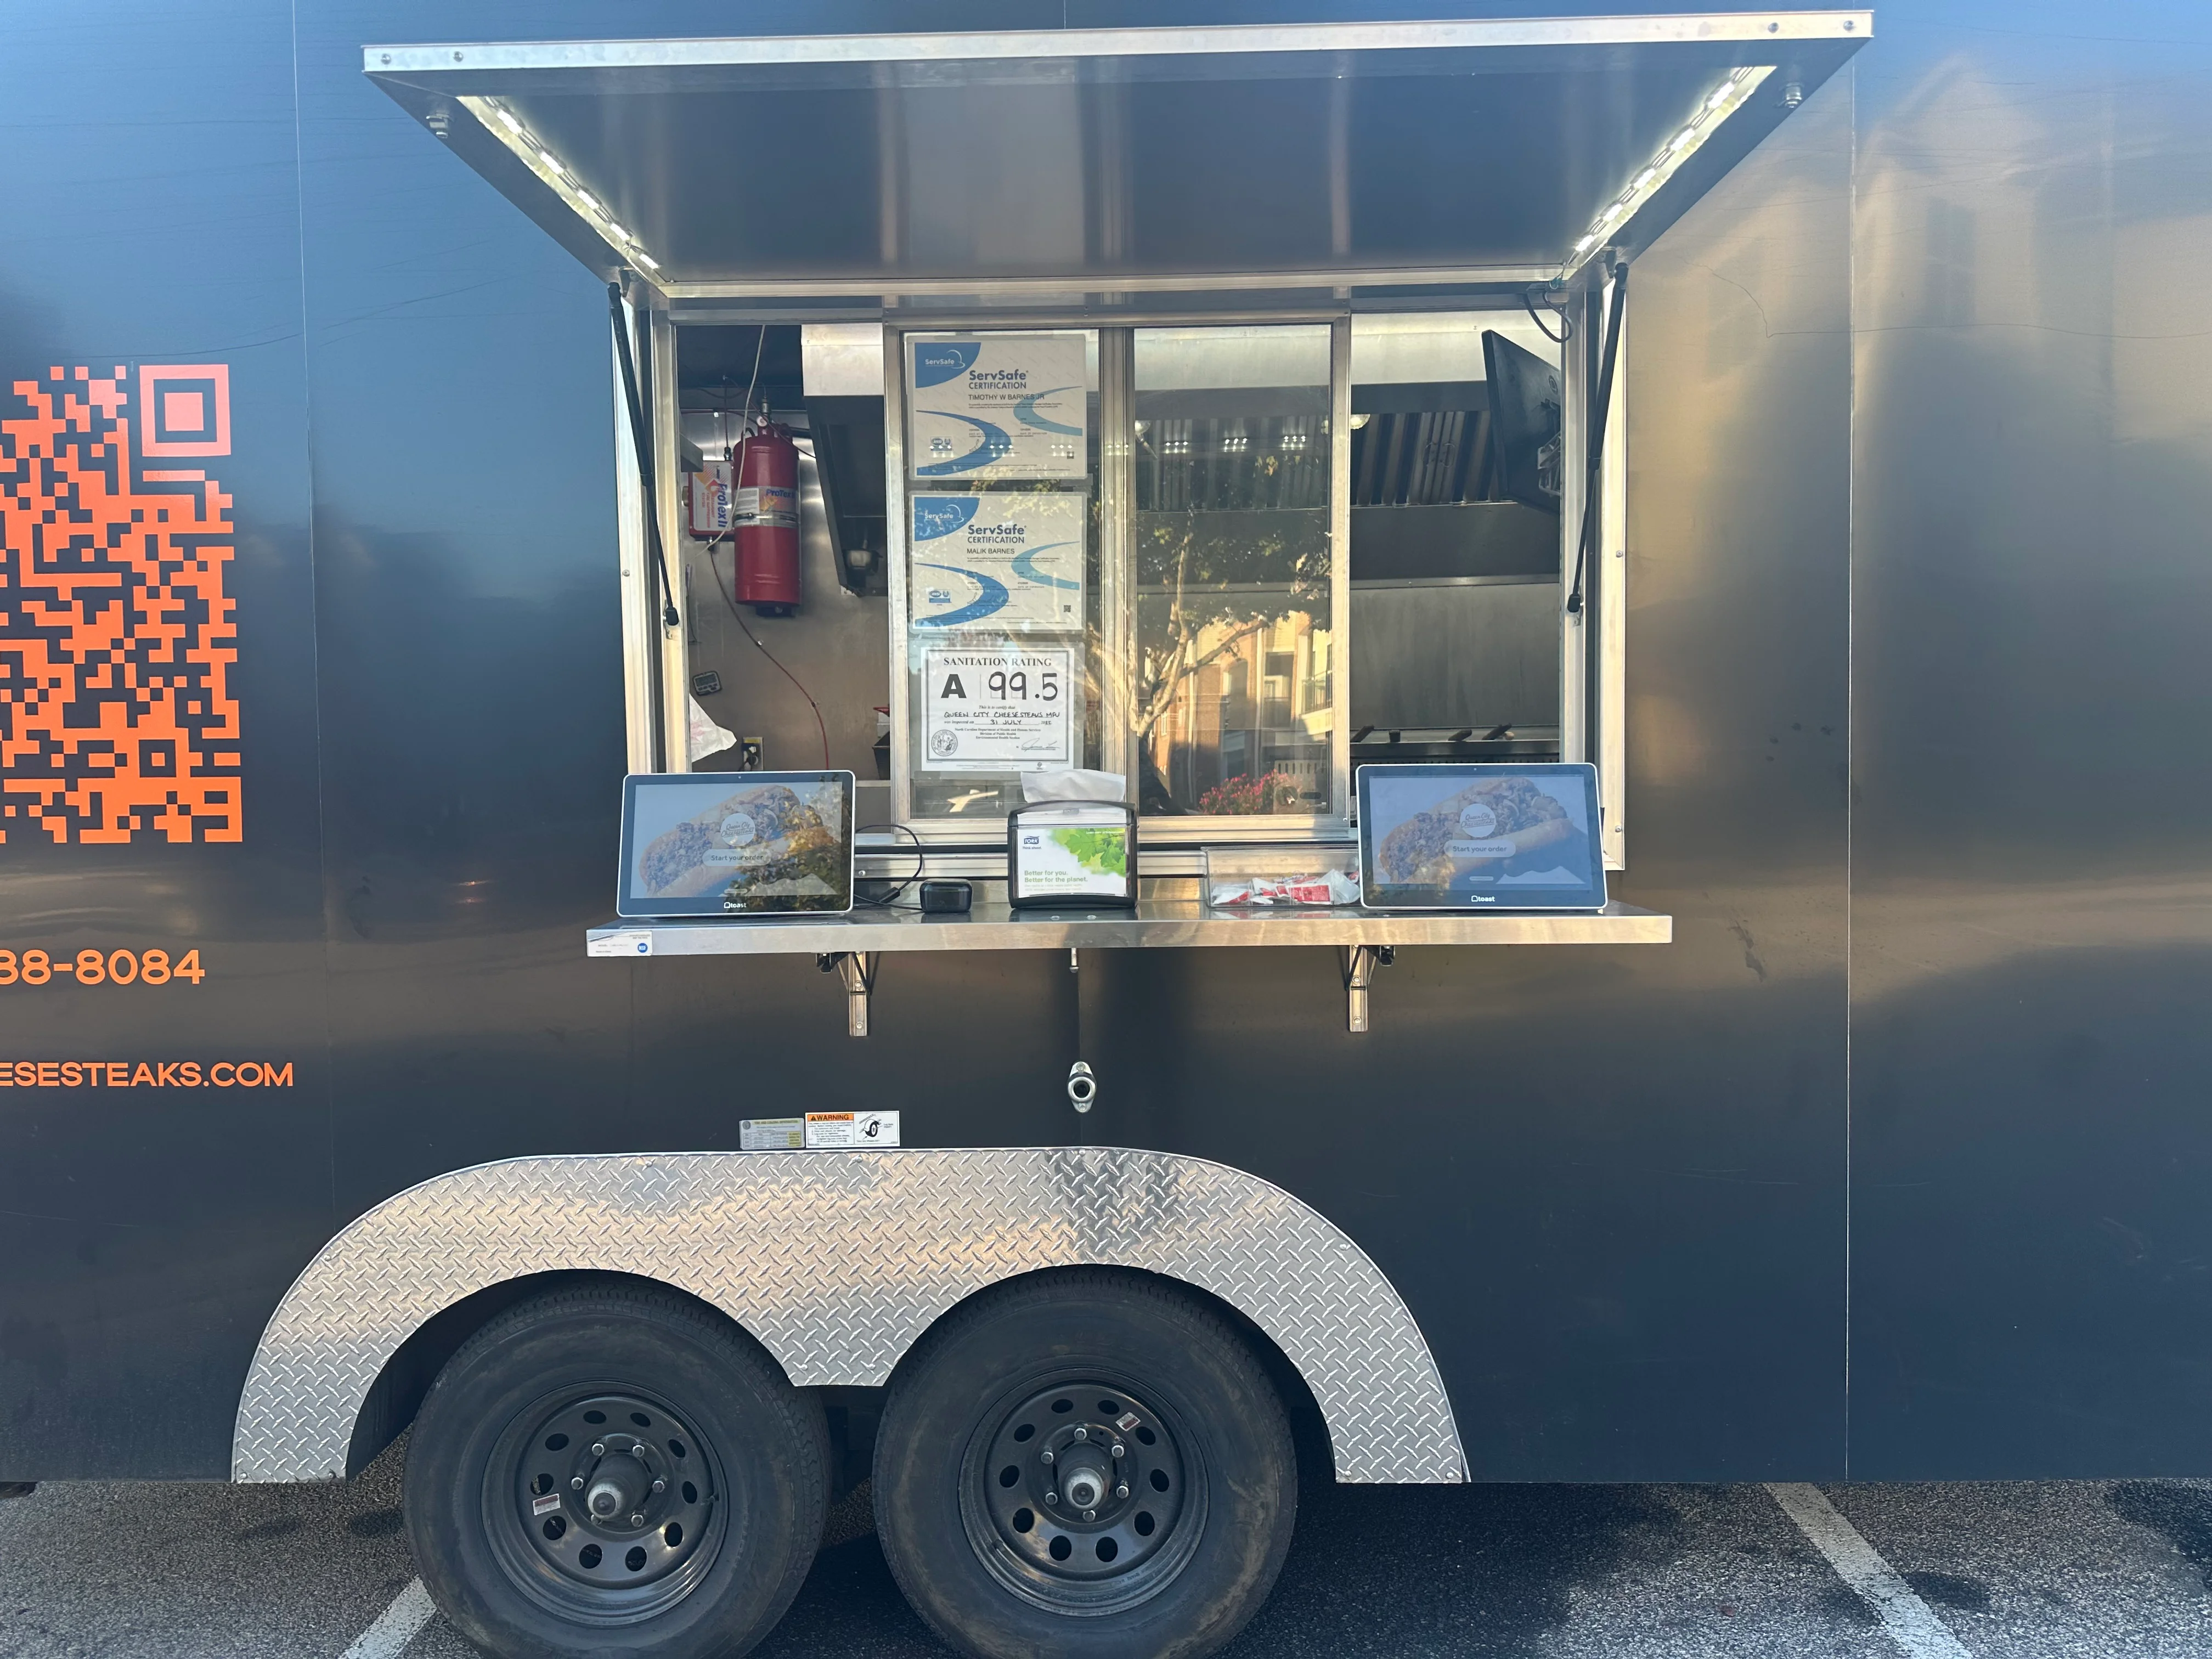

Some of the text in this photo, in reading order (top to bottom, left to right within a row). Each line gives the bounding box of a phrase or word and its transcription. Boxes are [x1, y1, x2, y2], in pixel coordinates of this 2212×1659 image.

[969, 369, 1026, 380] ServSafe
[968, 524, 1025, 535] ServSafe
[944, 657, 1052, 667] SANITATION RATING
[941, 671, 1058, 701] A 99.5
[0, 949, 205, 985] 88-8084
[0, 1061, 294, 1087] ESESTEAKS.COM
